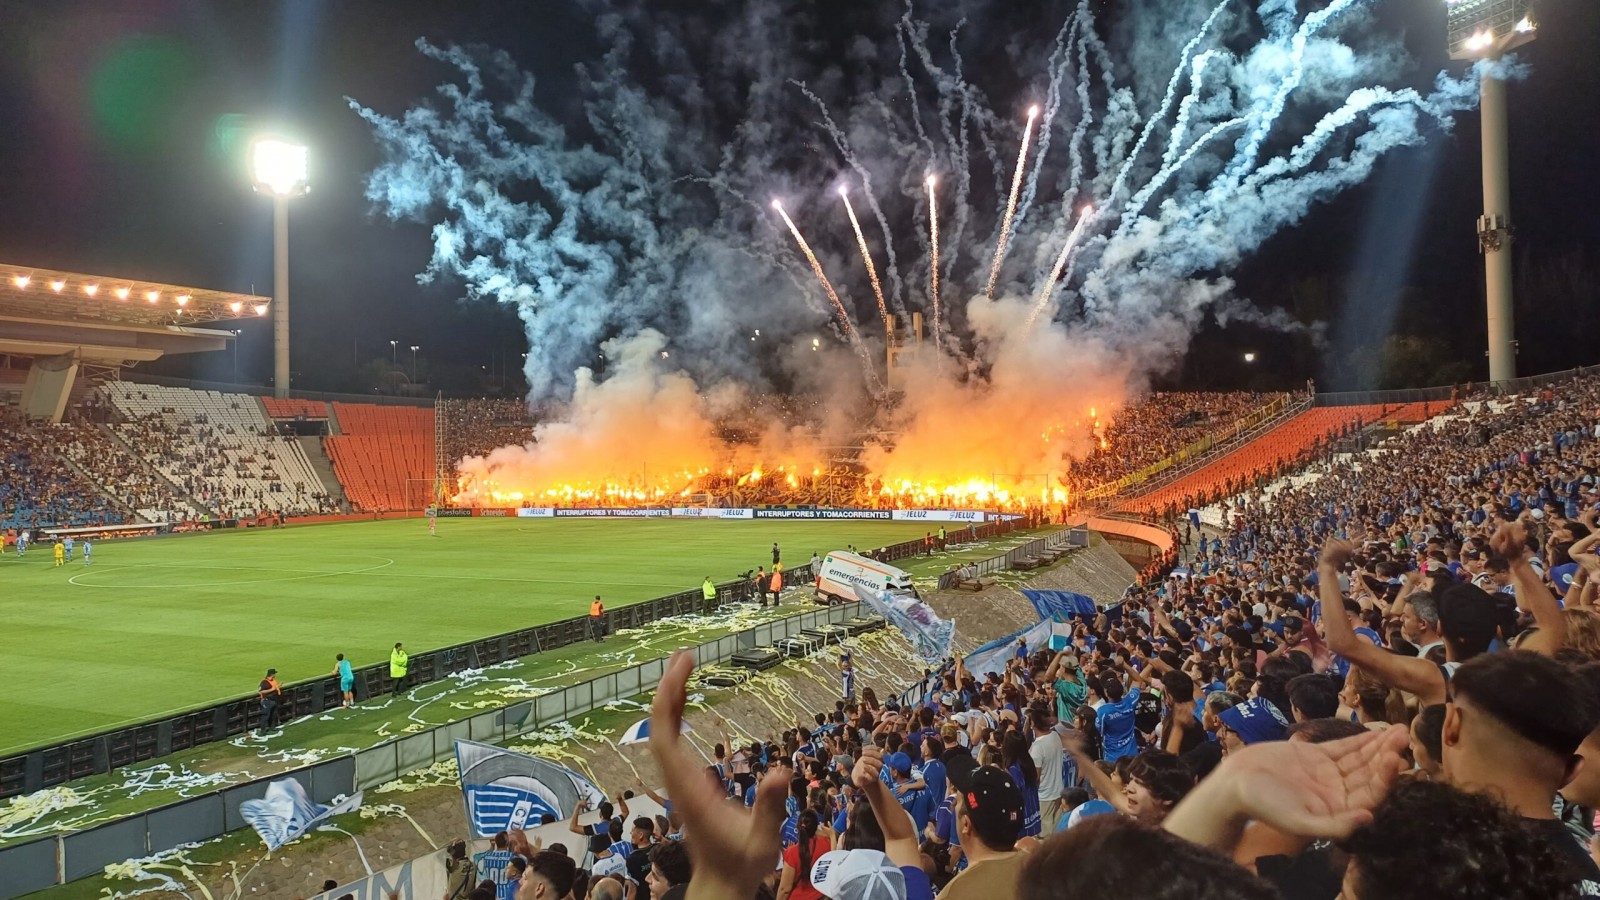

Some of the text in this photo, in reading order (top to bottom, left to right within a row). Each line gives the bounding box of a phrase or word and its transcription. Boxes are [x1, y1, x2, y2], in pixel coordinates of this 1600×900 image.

[480, 508, 507, 517] Schneider
[757, 510, 890, 519] INTERRUPTORES Y TOMACORRIENTES
[906, 510, 928, 518] JELUZ
[954, 511, 975, 520] JELUZ
[829, 568, 880, 590] emergencias
